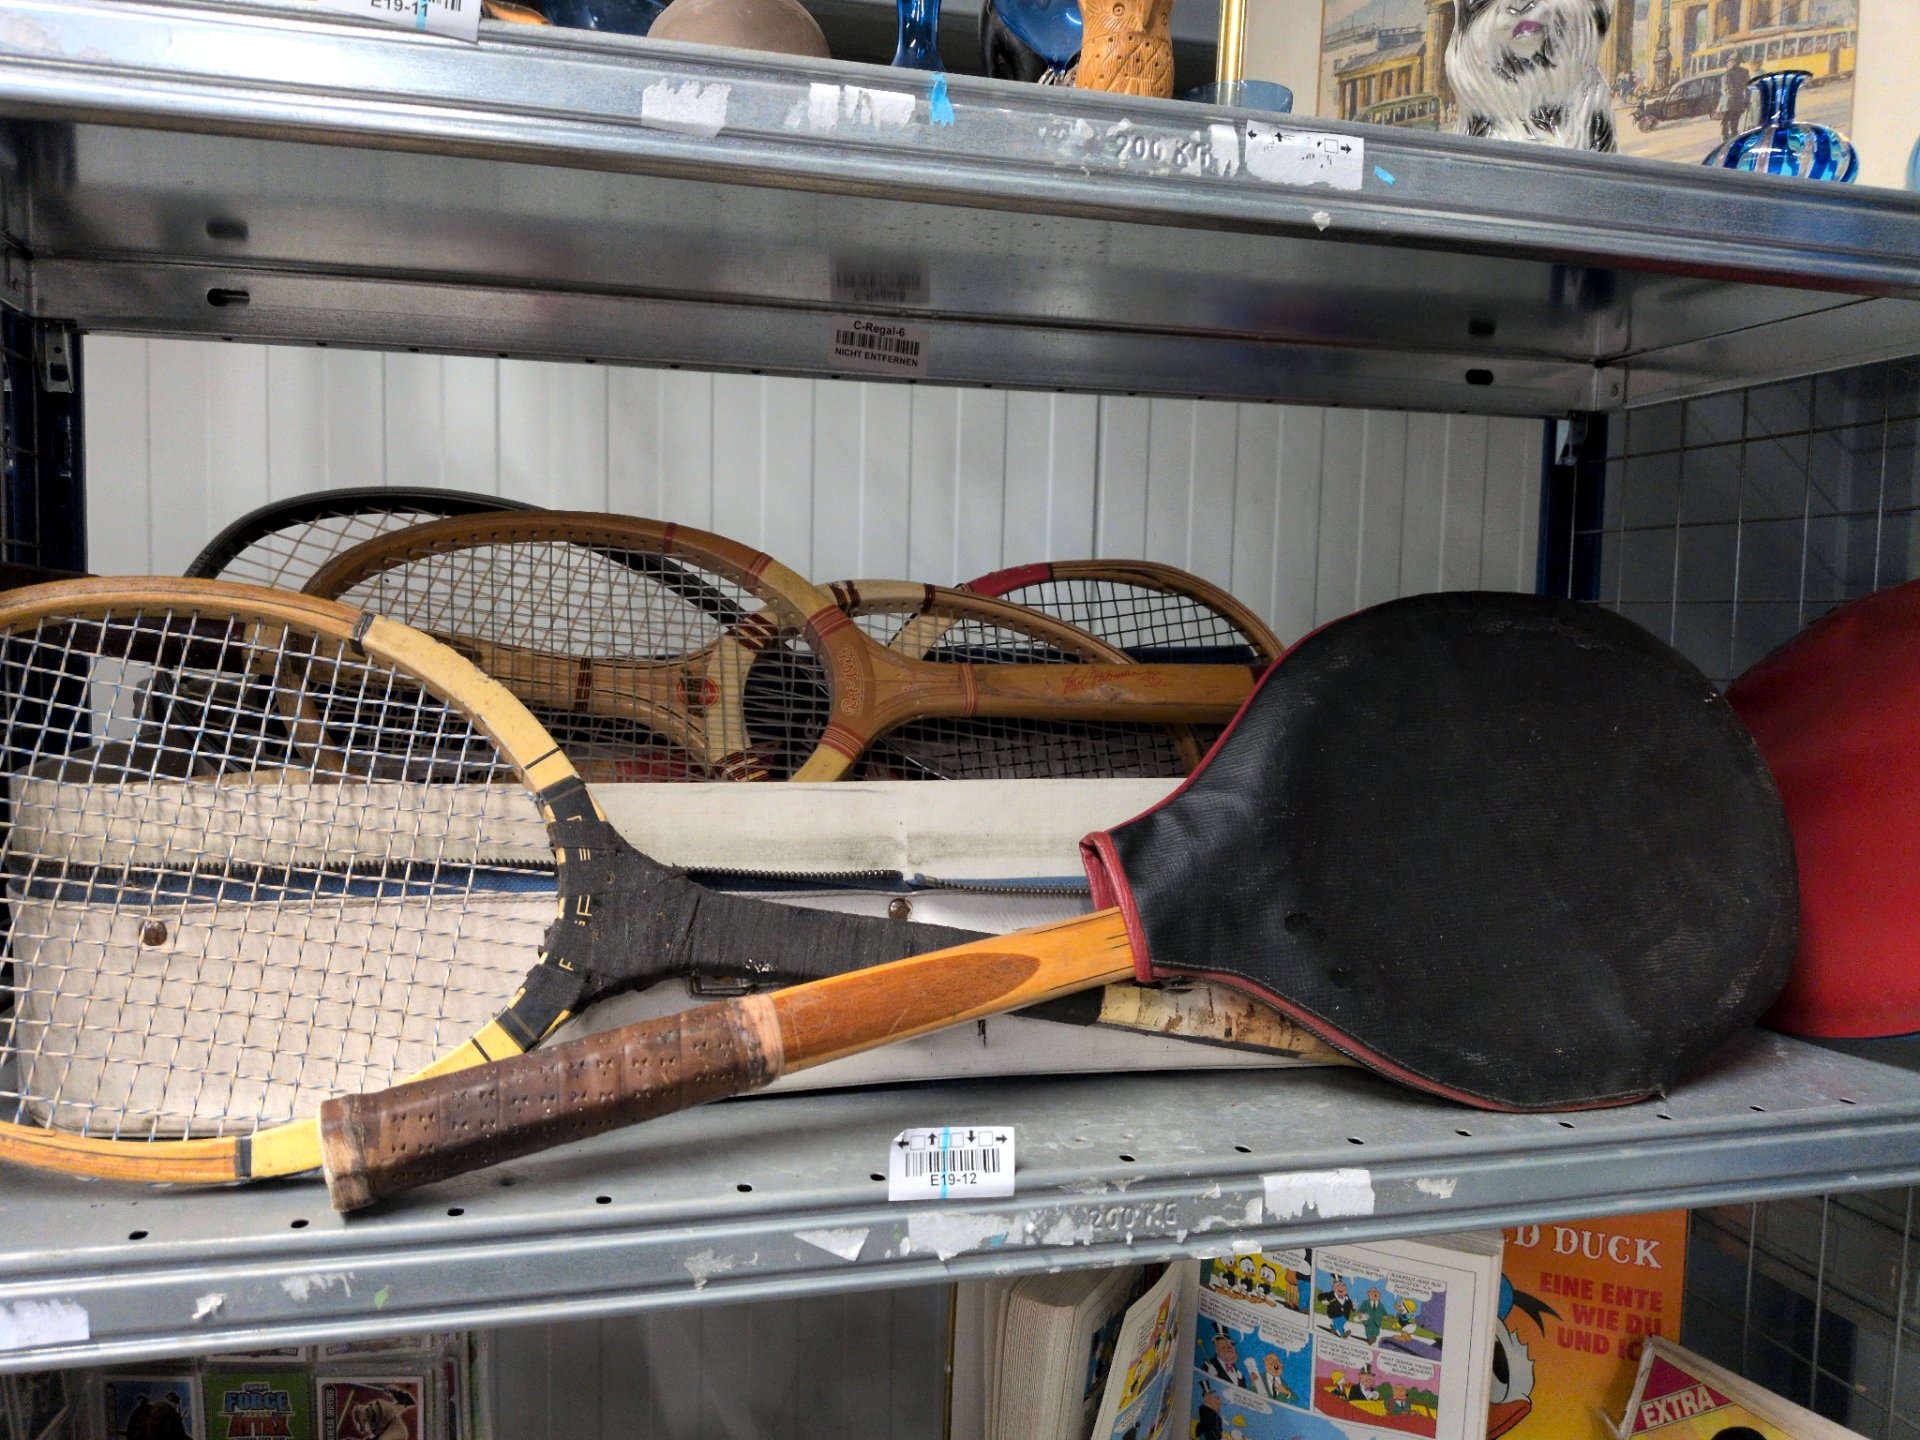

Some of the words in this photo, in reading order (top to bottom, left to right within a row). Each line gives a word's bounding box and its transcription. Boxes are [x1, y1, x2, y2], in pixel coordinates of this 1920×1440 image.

[371, 0, 429, 17] E19-11
[853, 320, 906, 337] C-Regal-6
[834, 346, 862, 358] NICHT
[864, 351, 918, 367] ENTFERNEN
[930, 1172, 978, 1187] E19-12
[1089, 1206, 1139, 1232] 200
[1505, 1224, 1541, 1249] D
[1553, 1226, 1662, 1269] DUCK
[1540, 1271, 1594, 1301] EINE
[1601, 1282, 1663, 1314] ENTE
[1572, 1302, 1619, 1332] WIE
[1626, 1312, 1662, 1337] DU
[1557, 1327, 1610, 1356] UND
[1618, 1338, 1643, 1363] IC
[224, 1390, 293, 1413] FORCE
[1640, 1384, 1718, 1429] EXTRA
